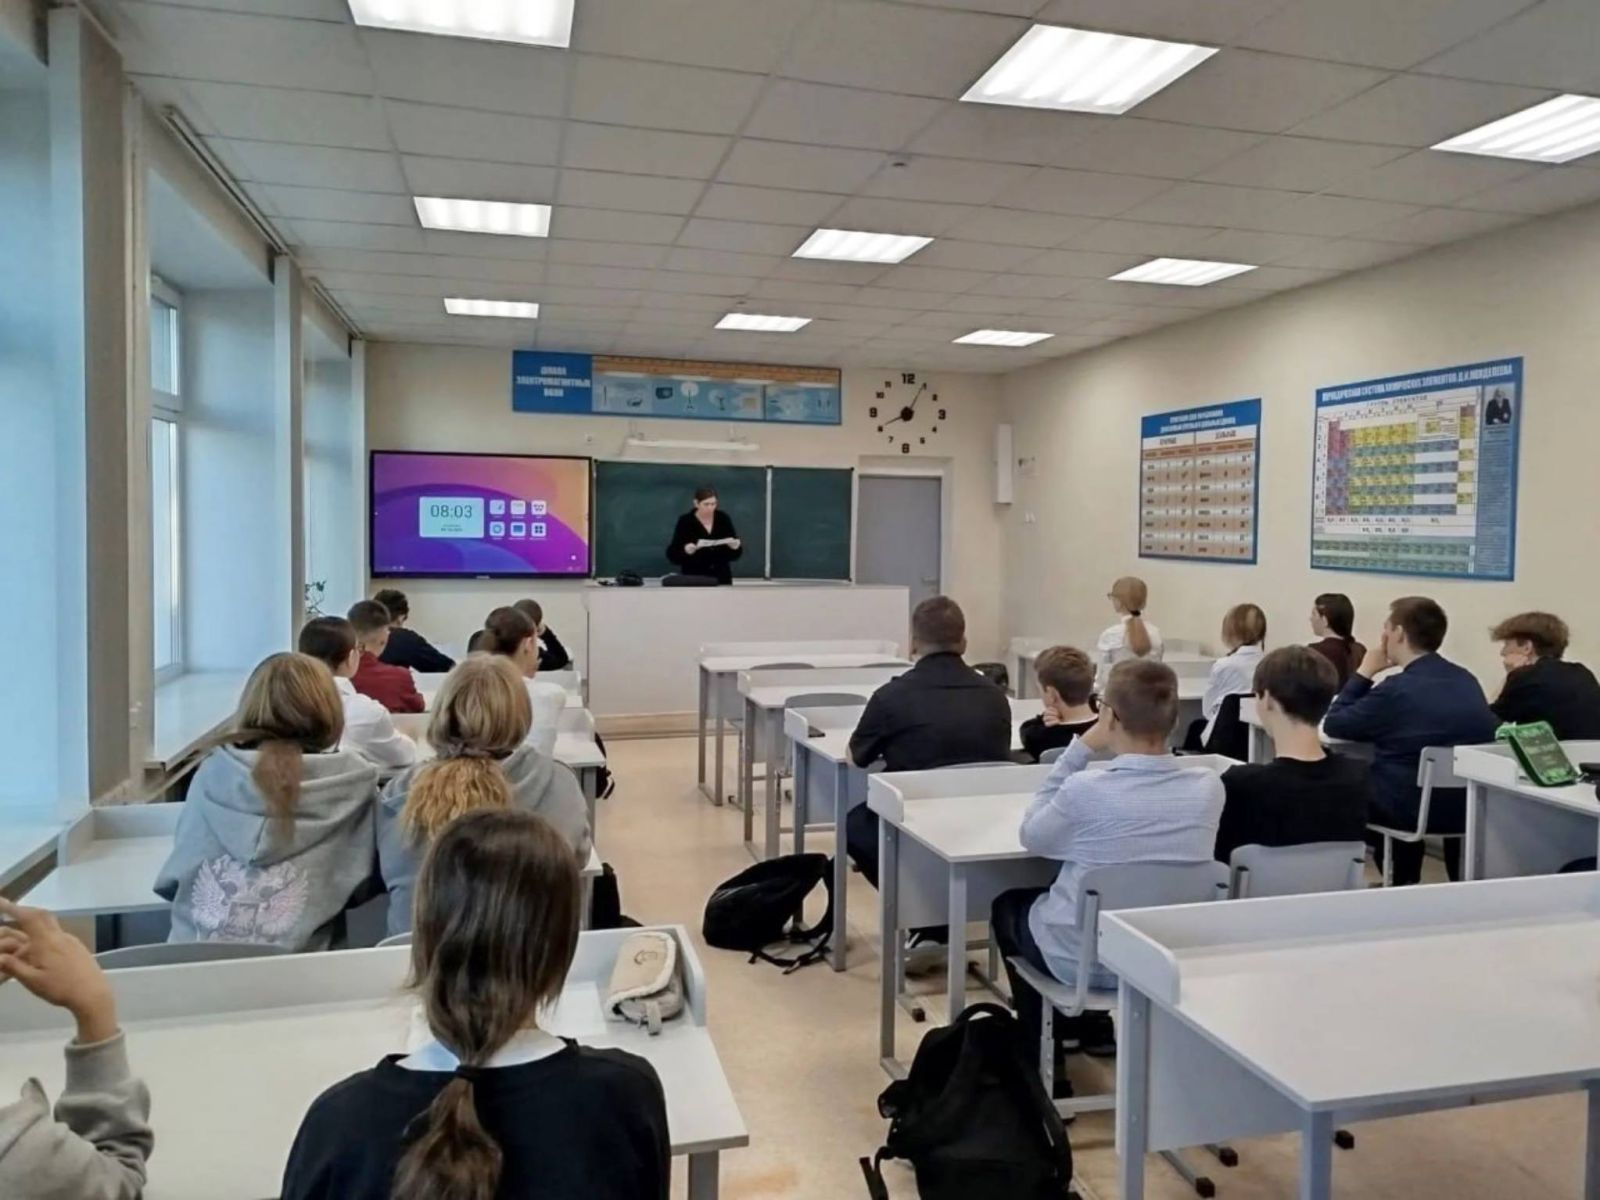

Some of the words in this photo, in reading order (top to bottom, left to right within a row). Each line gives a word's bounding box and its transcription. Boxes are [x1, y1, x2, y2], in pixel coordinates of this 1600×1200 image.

[902, 373, 915, 384] 12
[938, 408, 946, 420] 3
[430, 504, 473, 519] 08:03
